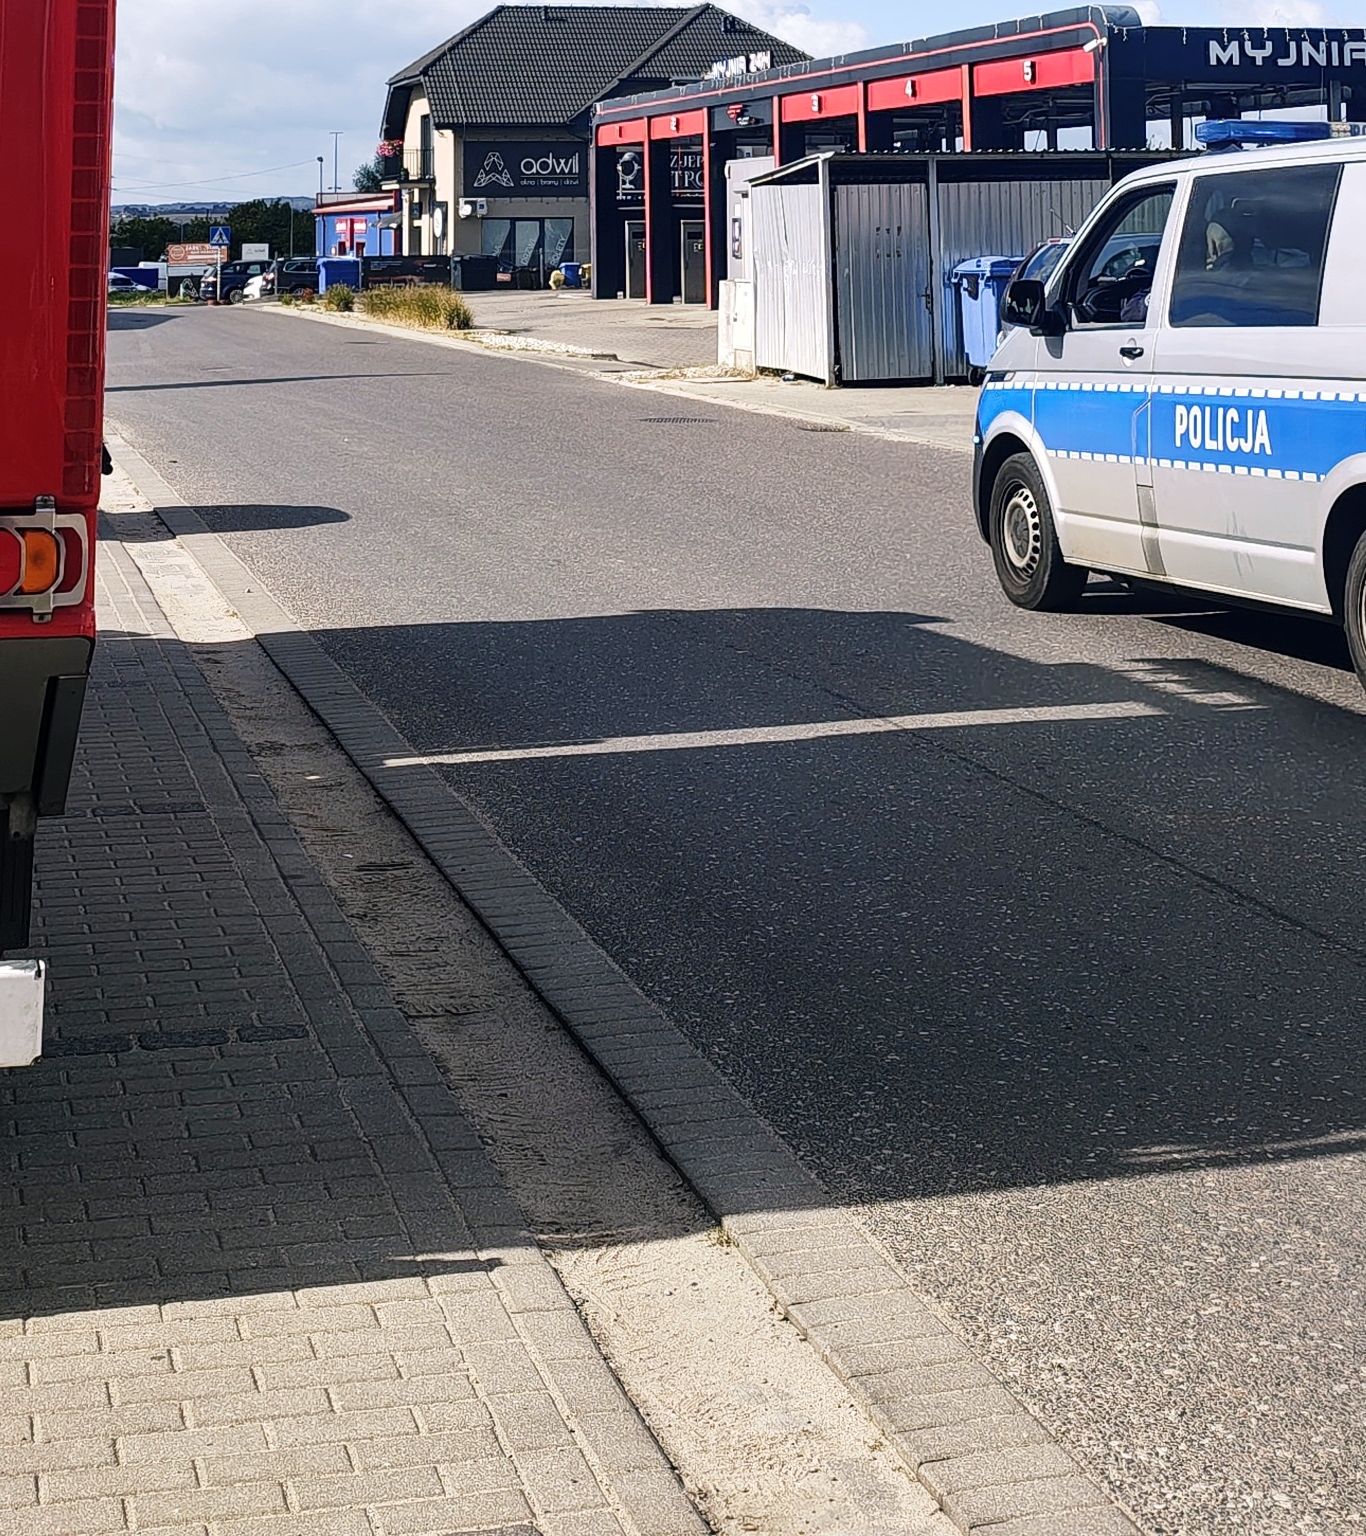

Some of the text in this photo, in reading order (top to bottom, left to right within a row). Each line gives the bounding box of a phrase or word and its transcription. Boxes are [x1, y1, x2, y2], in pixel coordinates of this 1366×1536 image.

[1022, 60, 1032, 82] 5
[904, 79, 913, 98] 4
[520, 152, 579, 174] adwil
[1173, 404, 1272, 455] POLICJA
